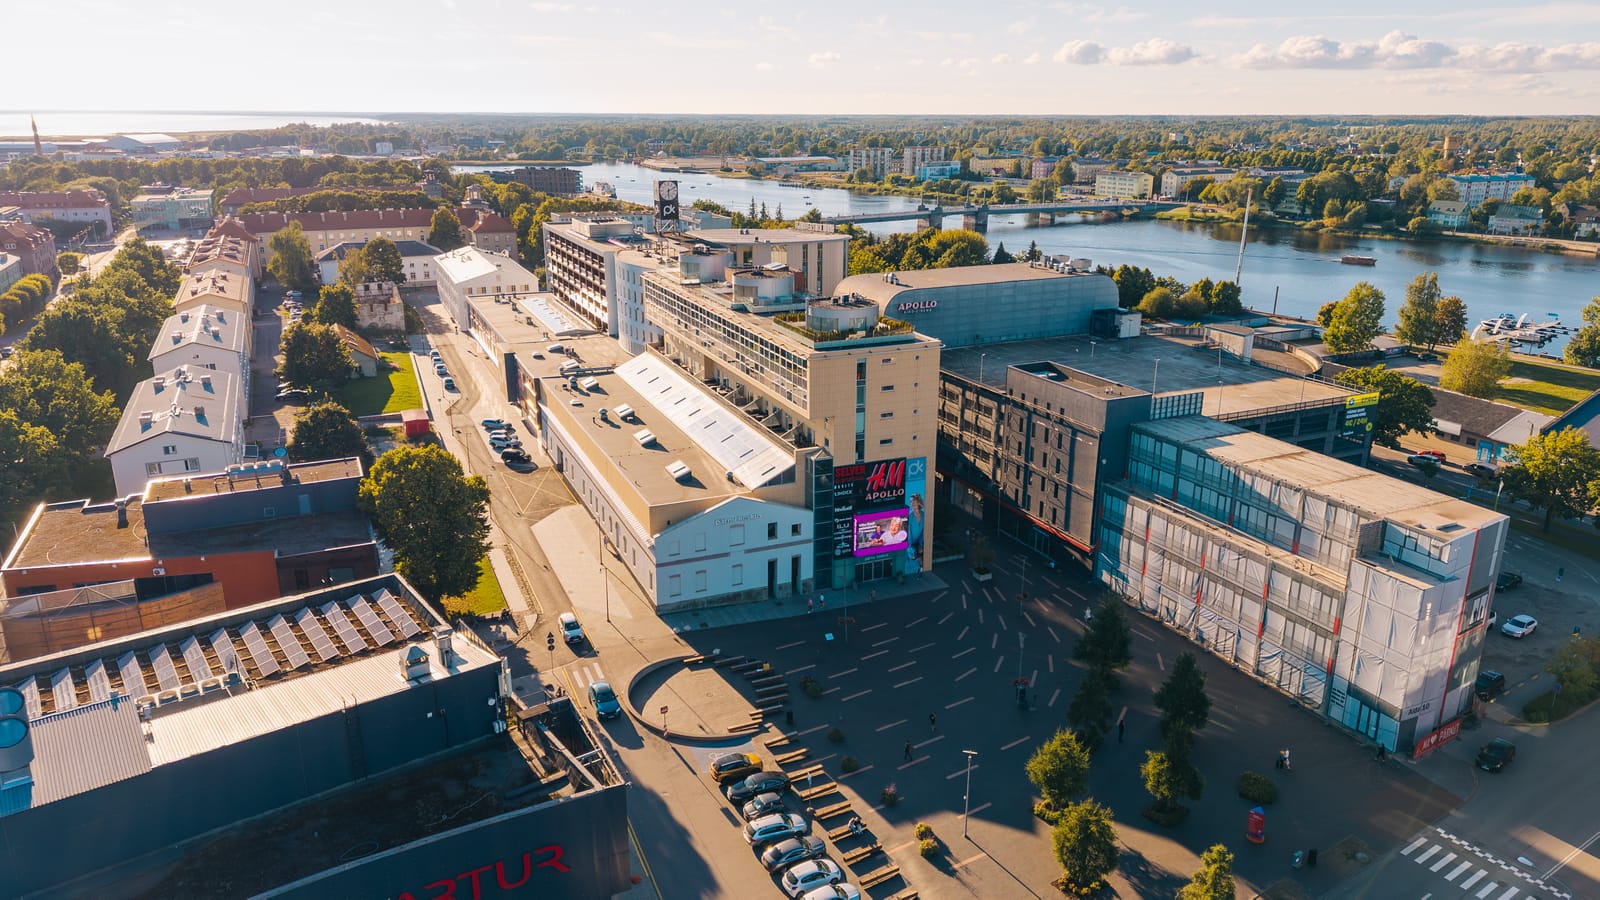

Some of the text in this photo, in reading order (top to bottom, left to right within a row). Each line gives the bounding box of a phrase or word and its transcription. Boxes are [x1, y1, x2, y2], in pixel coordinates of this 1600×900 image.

[898, 300, 938, 311] APOLLO
[835, 465, 866, 478] SELVER
[866, 460, 905, 492] H&M
[865, 488, 905, 501] APOLLO
[398, 845, 572, 900] RTUR
